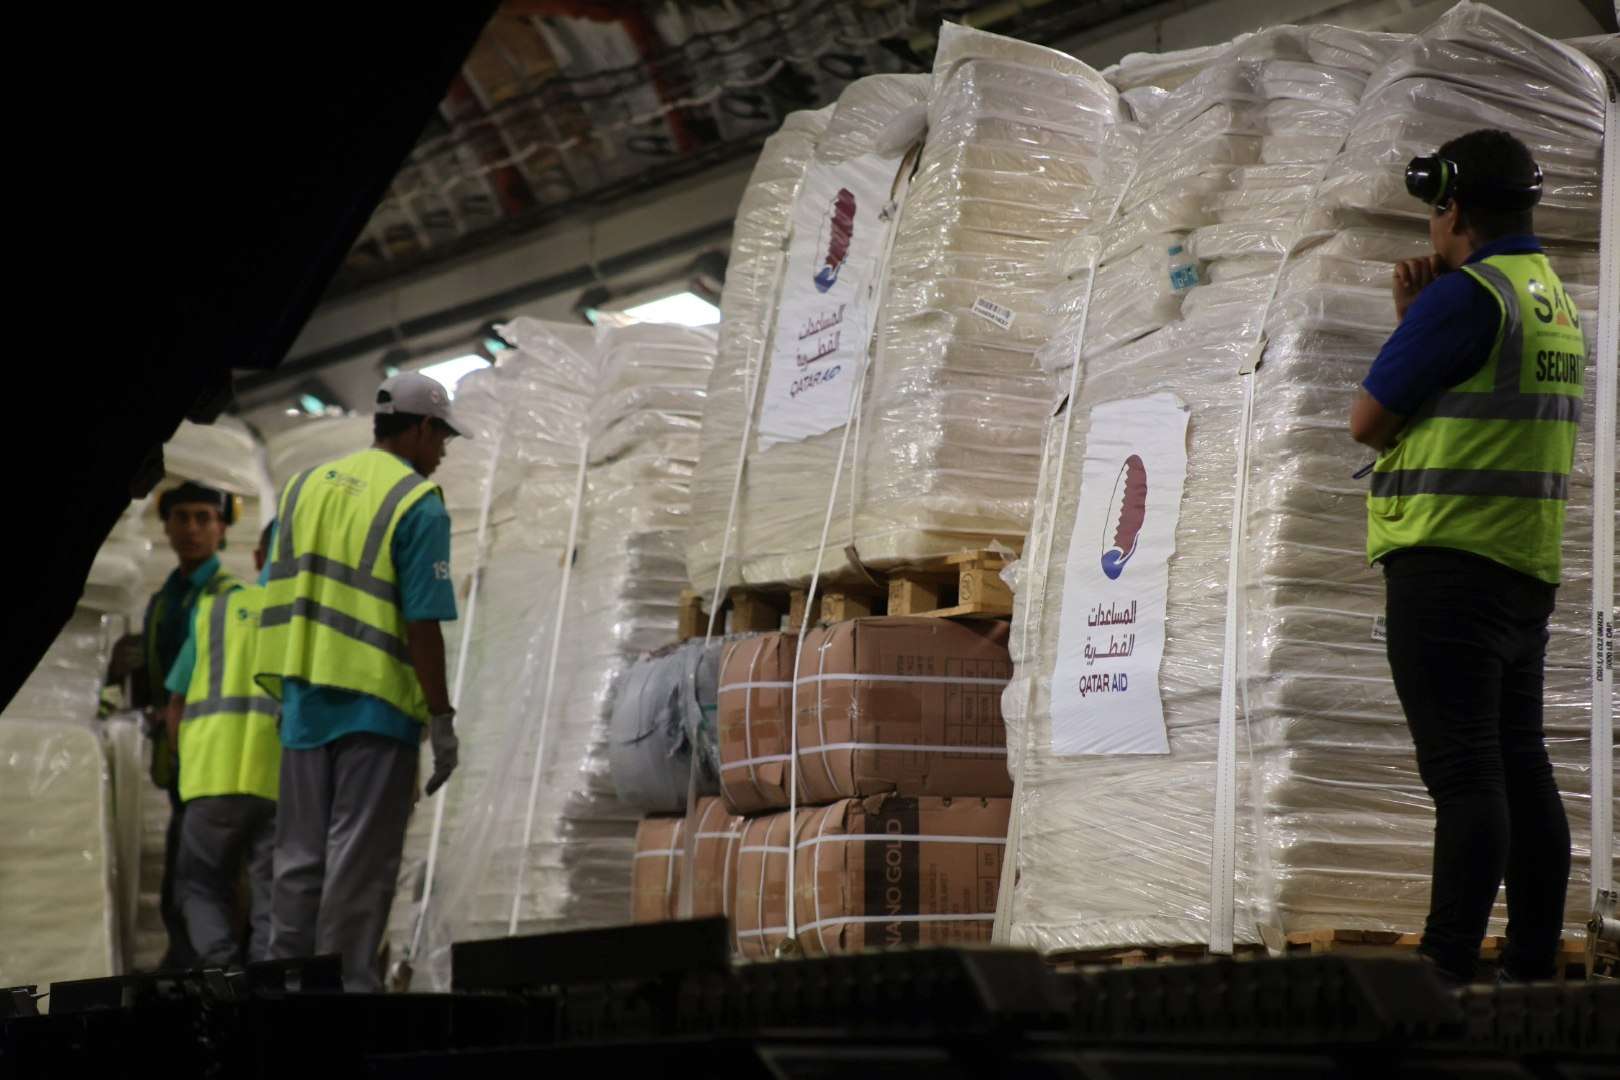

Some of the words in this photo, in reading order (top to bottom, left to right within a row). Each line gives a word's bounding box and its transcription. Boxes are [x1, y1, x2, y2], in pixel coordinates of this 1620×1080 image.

[790, 371, 821, 398] QATAR
[822, 365, 841, 382] AID
[1088, 599, 1137, 627] المساعدات
[1084, 633, 1135, 666] القطرية
[1079, 673, 1110, 697] QATAR
[1112, 673, 1128, 692] AID
[885, 818, 901, 883] GOLD
